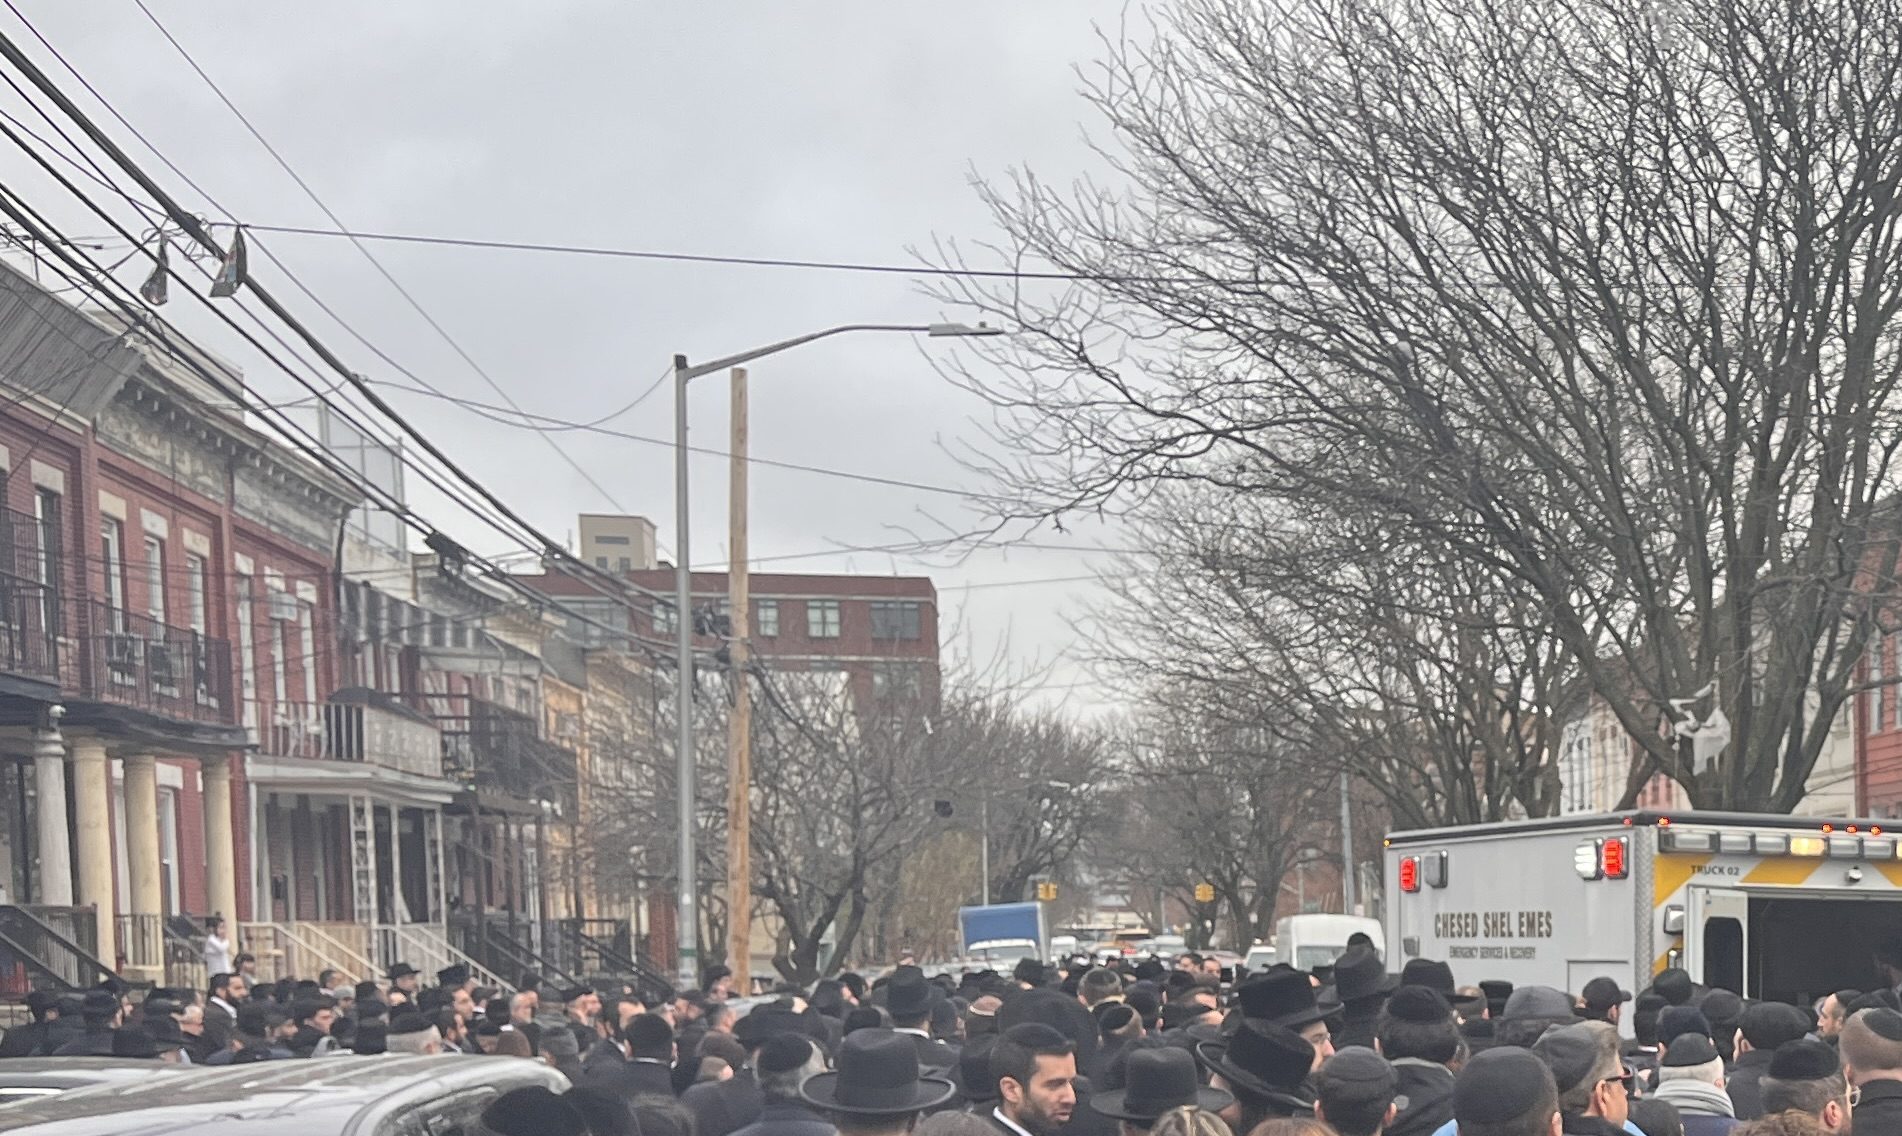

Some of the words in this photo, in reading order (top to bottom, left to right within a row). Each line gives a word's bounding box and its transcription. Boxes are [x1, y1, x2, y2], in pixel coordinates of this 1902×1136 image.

[1690, 864, 1726, 876] TRUCK
[1727, 865, 1740, 877] 02
[1434, 911, 1479, 939] CHESED
[1483, 910, 1514, 939] SHEL
[1518, 910, 1553, 939] EMES
